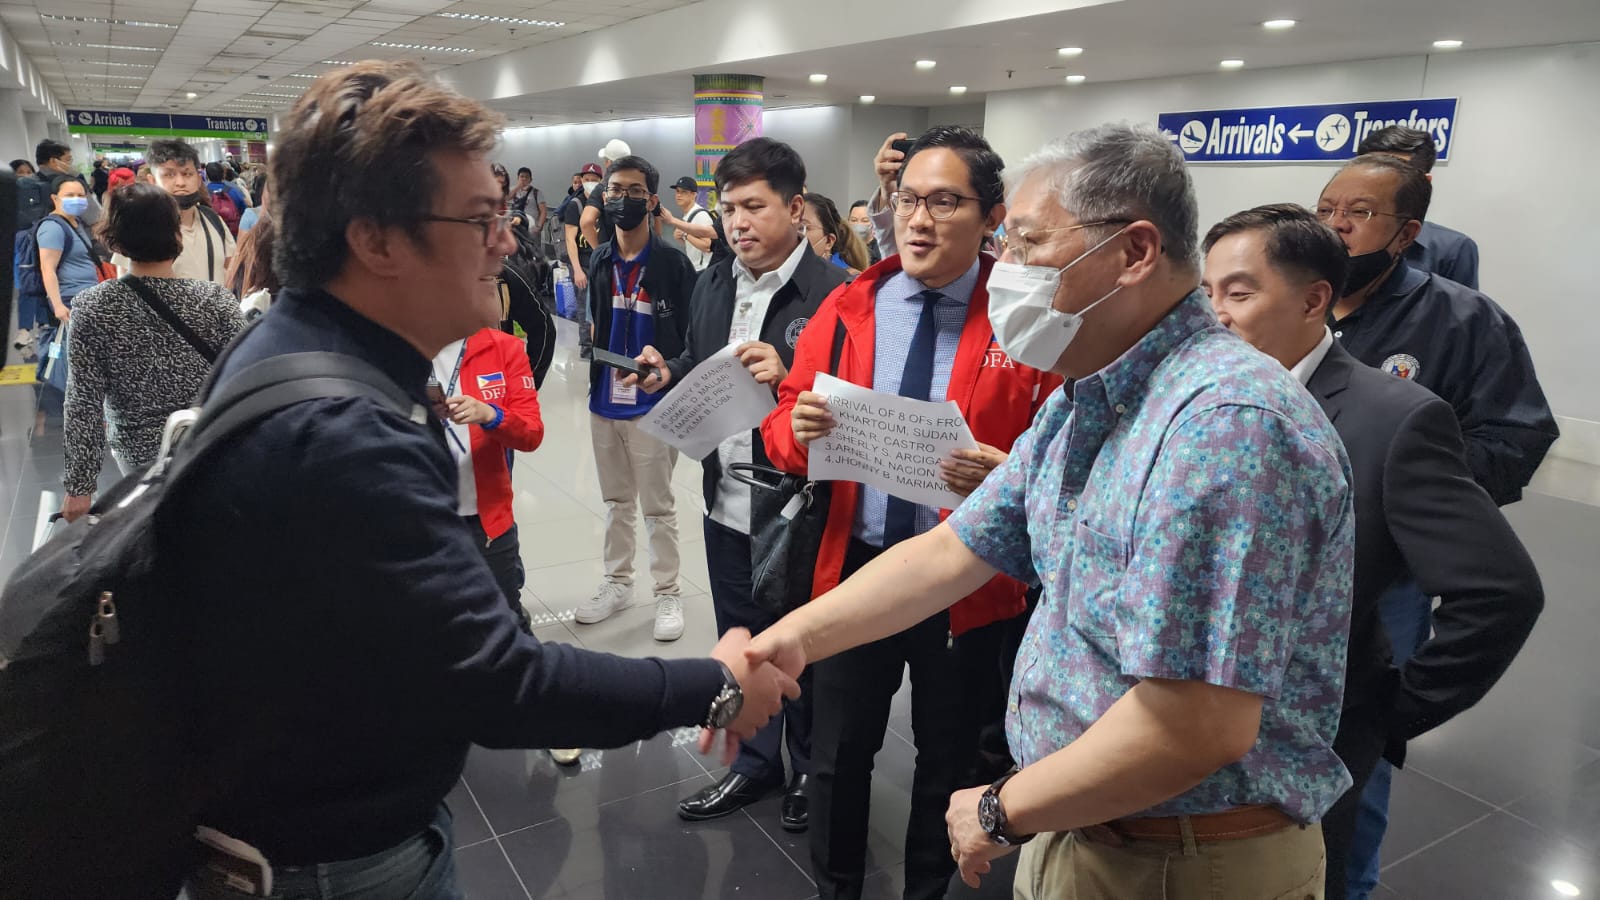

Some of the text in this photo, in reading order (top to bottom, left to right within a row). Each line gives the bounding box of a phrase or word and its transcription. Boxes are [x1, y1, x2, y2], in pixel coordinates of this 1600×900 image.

[94, 113, 131, 126] Arrivals
[205, 117, 245, 131] Transfers
[1206, 115, 1286, 155] Arrivals
[1352, 108, 1450, 152] Trfrs
[828, 394, 875, 415] ARRIVAL
[878, 407, 896, 418] OF
[898, 411, 906, 421] 8
[909, 414, 933, 426] OFs
[913, 427, 958, 441] SUDAN
[884, 436, 936, 453] CASTRO
[895, 451, 942, 466] ARCIGA
[889, 461, 935, 477] NACION
